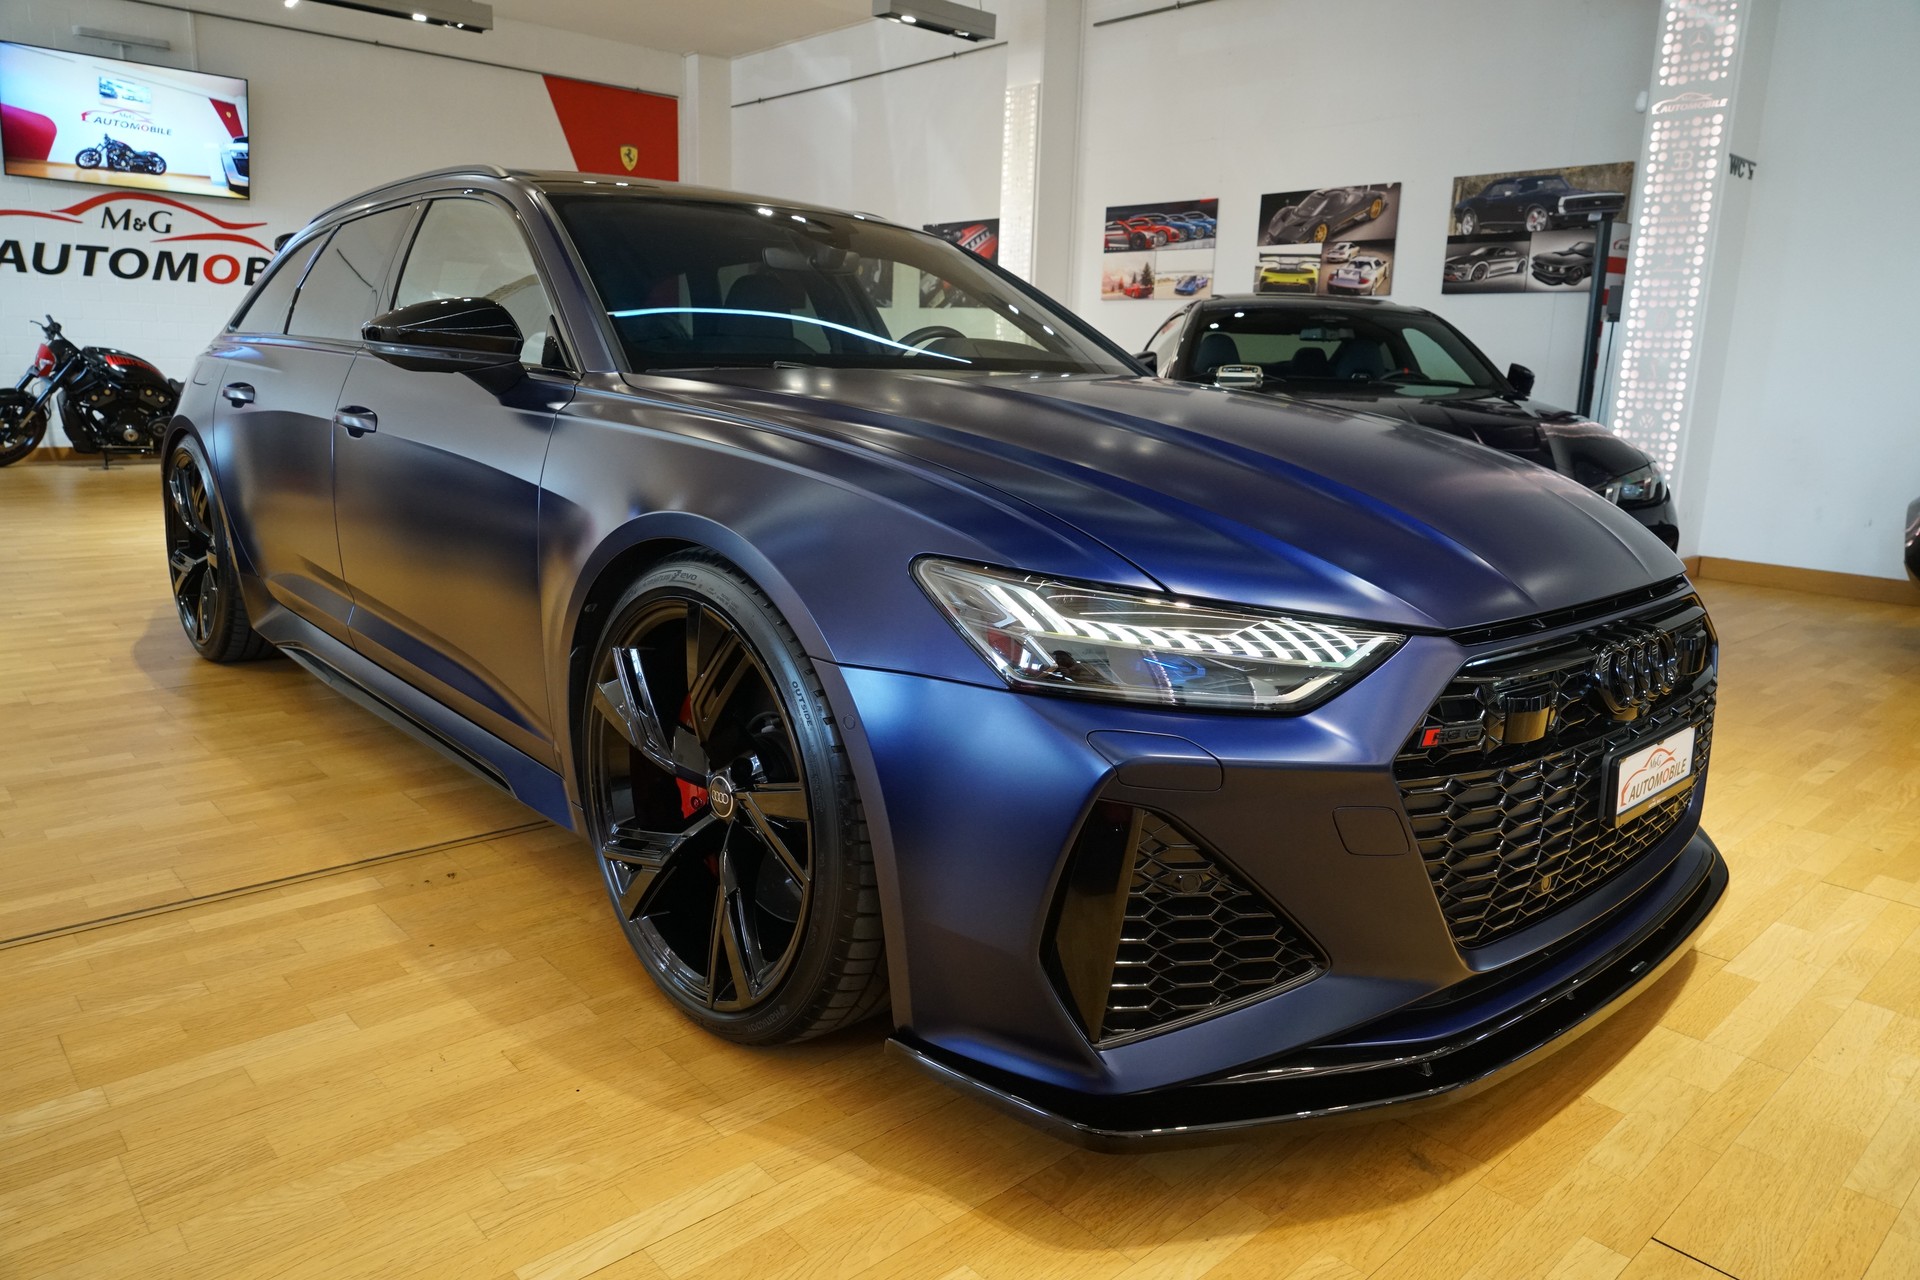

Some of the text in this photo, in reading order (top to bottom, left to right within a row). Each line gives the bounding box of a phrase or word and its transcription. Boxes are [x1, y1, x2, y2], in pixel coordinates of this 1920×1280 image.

[1660, 98, 1728, 113] AUTOMOBILE
[93, 116, 172, 136] AUTOMOBILE
[101, 206, 173, 234] M&G
[792, 681, 813, 727] OUTSIDE
[1628, 758, 1687, 802] AUTOMOBILE
